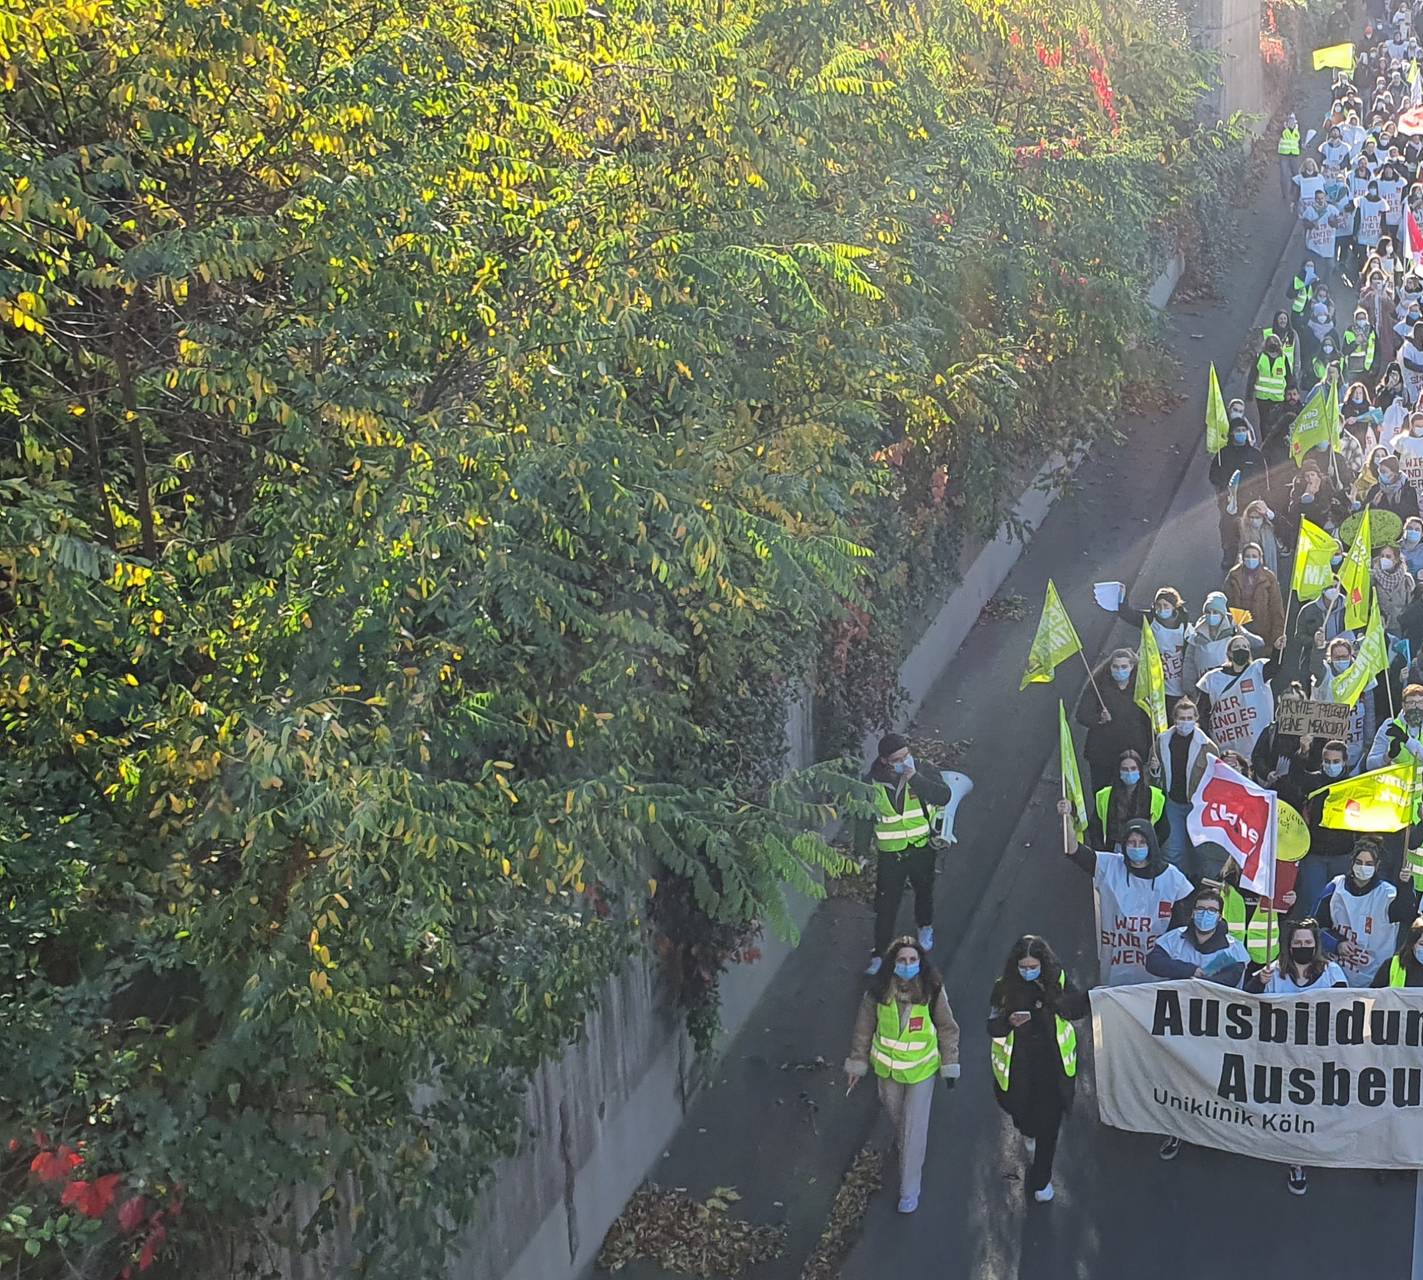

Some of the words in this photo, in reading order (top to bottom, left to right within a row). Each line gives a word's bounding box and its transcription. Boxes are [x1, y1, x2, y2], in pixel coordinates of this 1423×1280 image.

[1115, 914, 1152, 933] WIR
[1111, 949, 1145, 967] WER
[1154, 1088, 1255, 1128] Uniklinik
[1261, 1113, 1315, 1134] Köln
